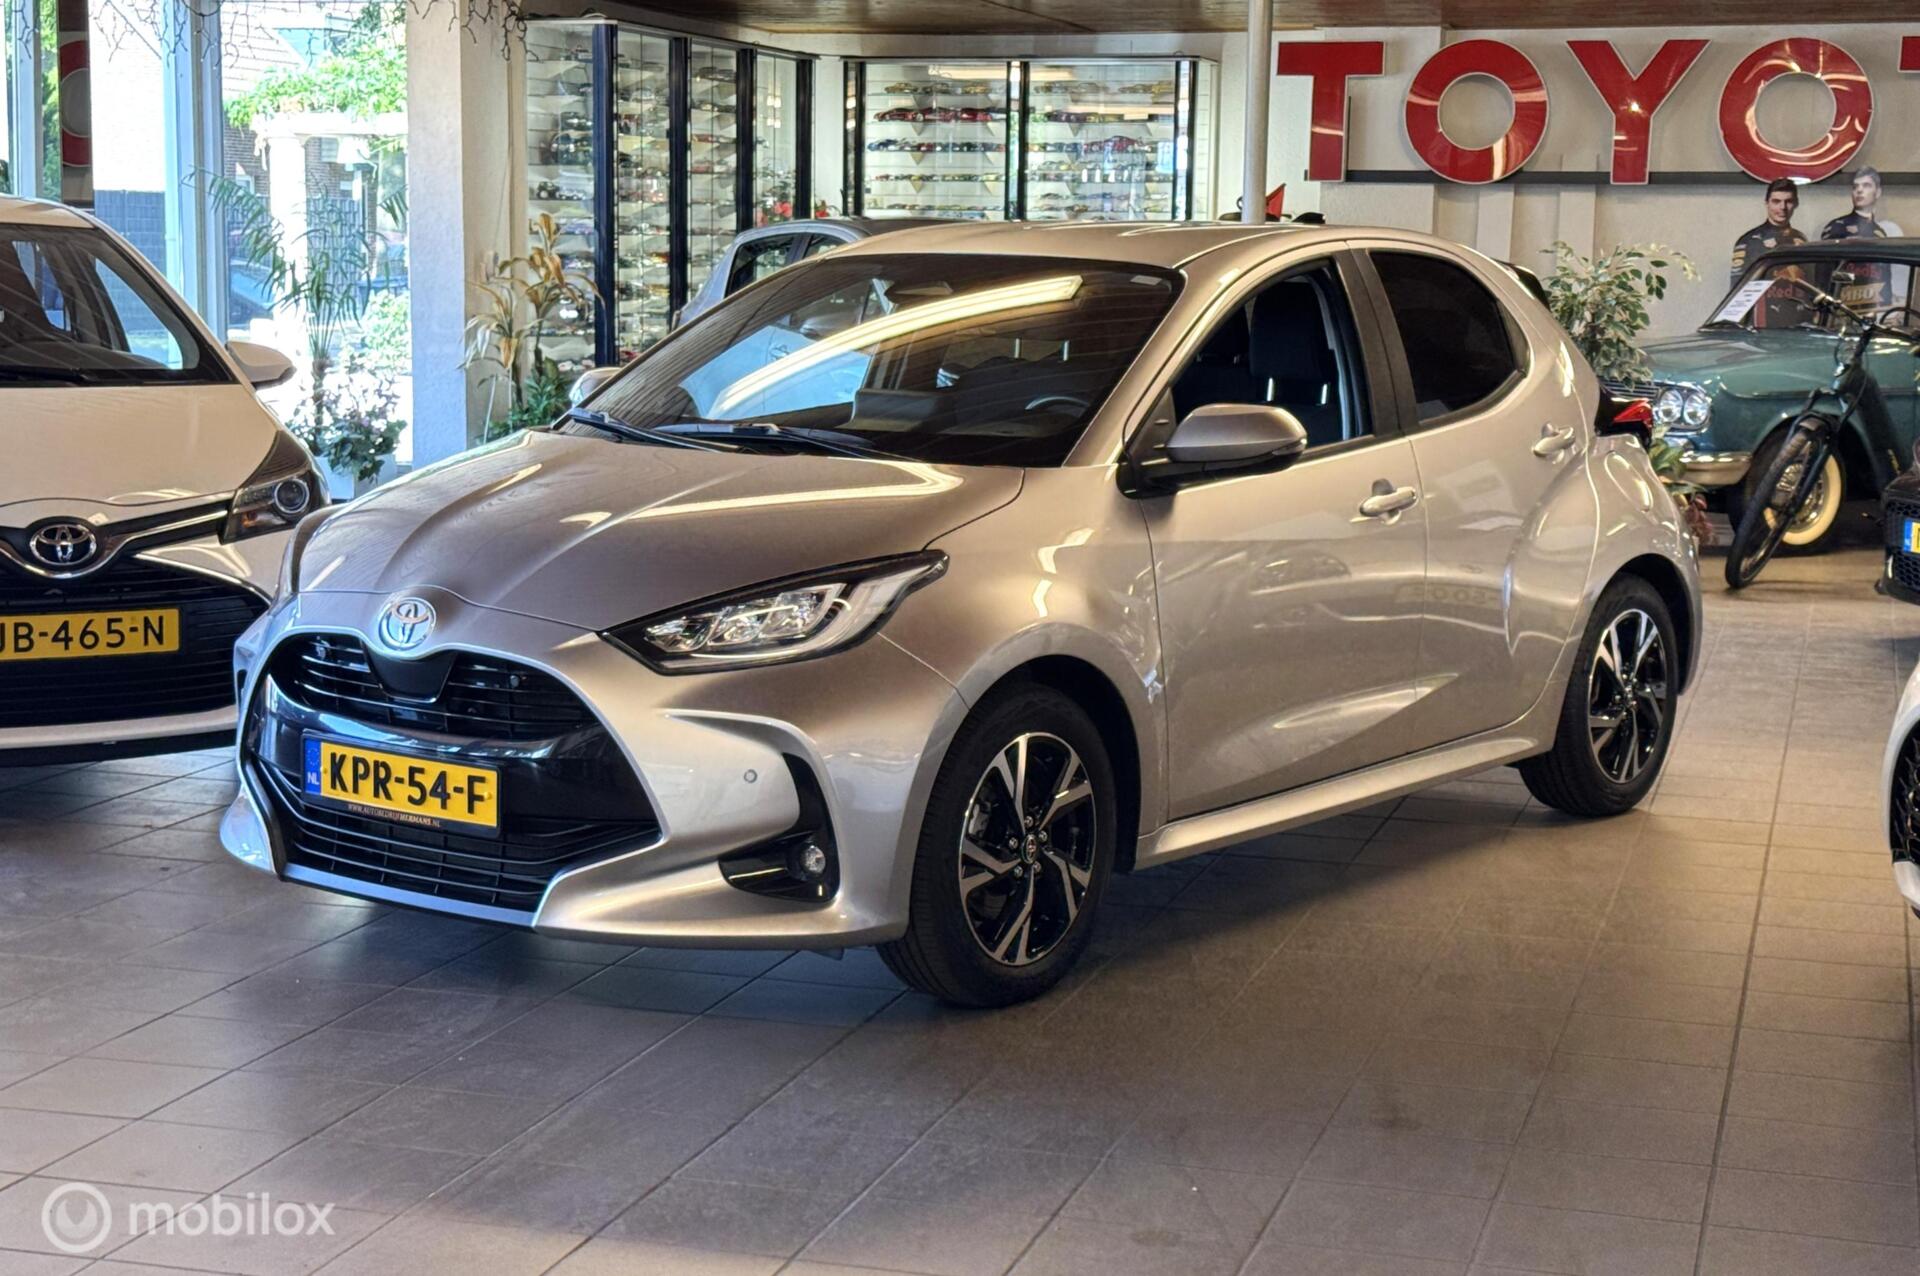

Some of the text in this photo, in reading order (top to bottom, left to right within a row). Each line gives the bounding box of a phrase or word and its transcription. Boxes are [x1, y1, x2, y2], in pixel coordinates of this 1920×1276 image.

[1276, 36, 1920, 186] TOYO
[307, 771, 320, 785] NL
[330, 752, 487, 815] KPR-54-F
